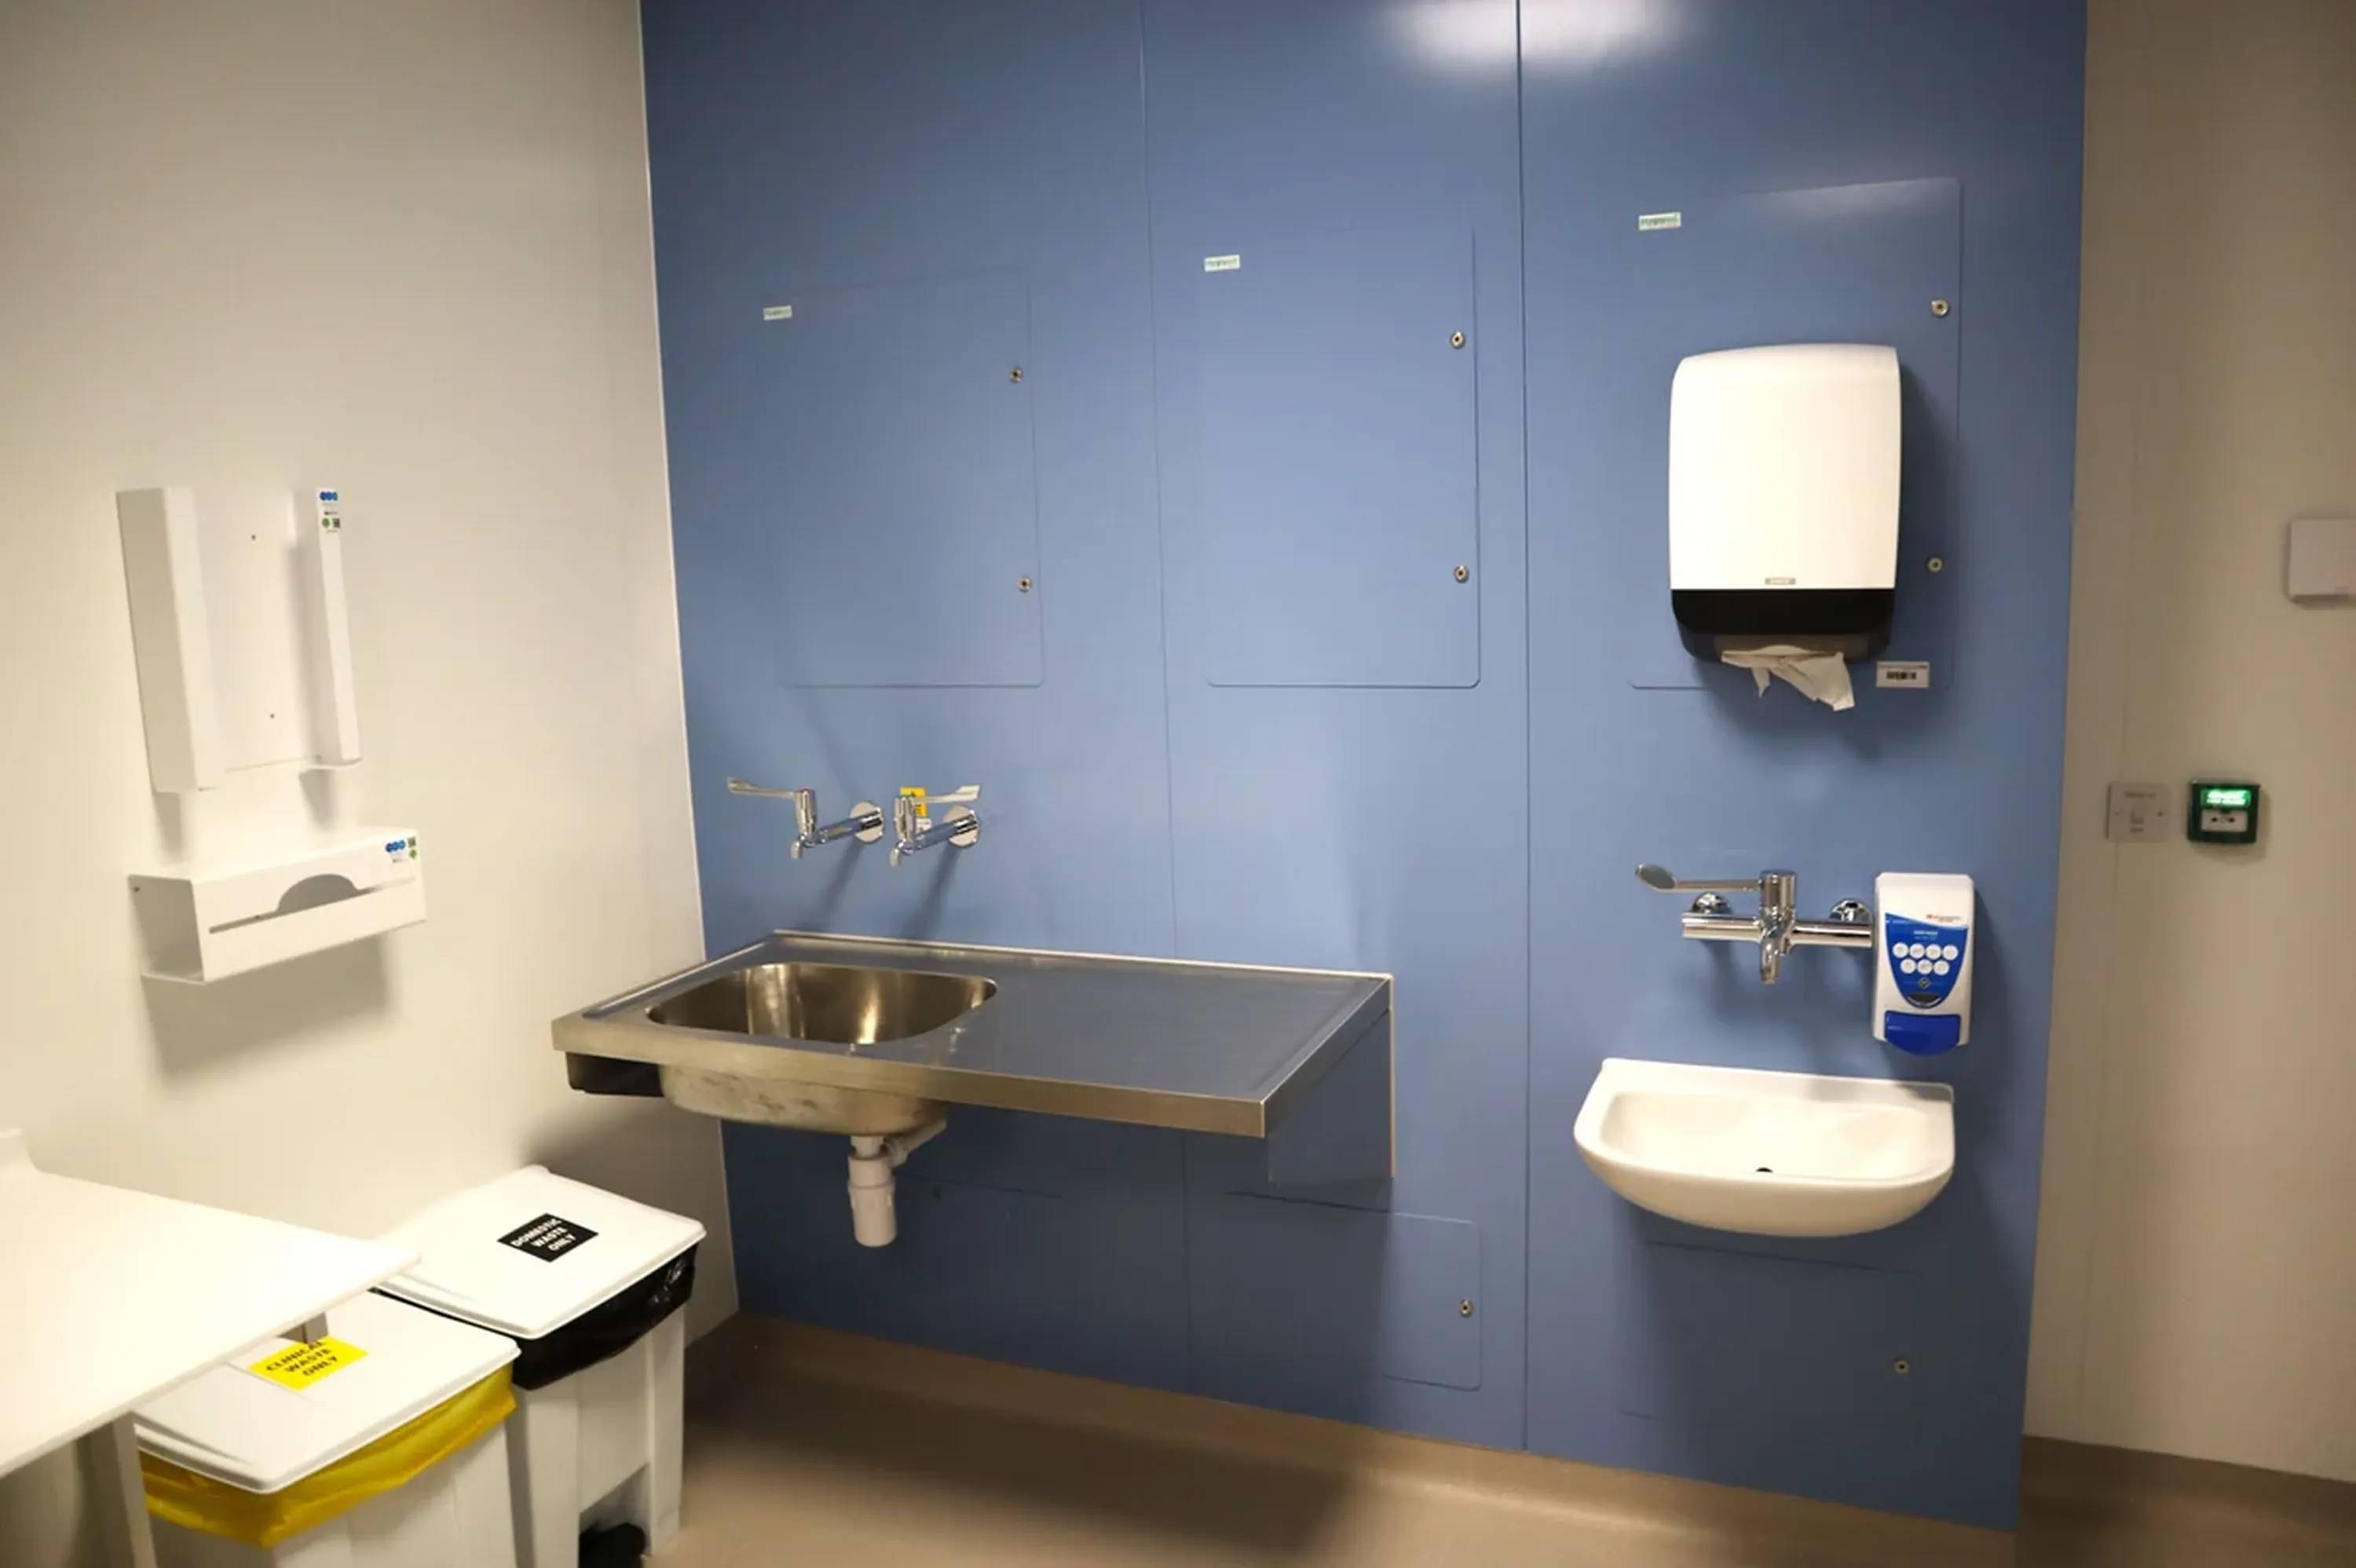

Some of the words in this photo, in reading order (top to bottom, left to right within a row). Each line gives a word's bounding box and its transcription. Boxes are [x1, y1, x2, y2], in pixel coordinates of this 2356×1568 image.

[510, 1218, 562, 1247] DOMESTIC
[531, 1226, 567, 1247] WASTE
[547, 1234, 576, 1251] ONLY
[284, 1348, 331, 1372] WASTE
[302, 1355, 338, 1376] ONLY
